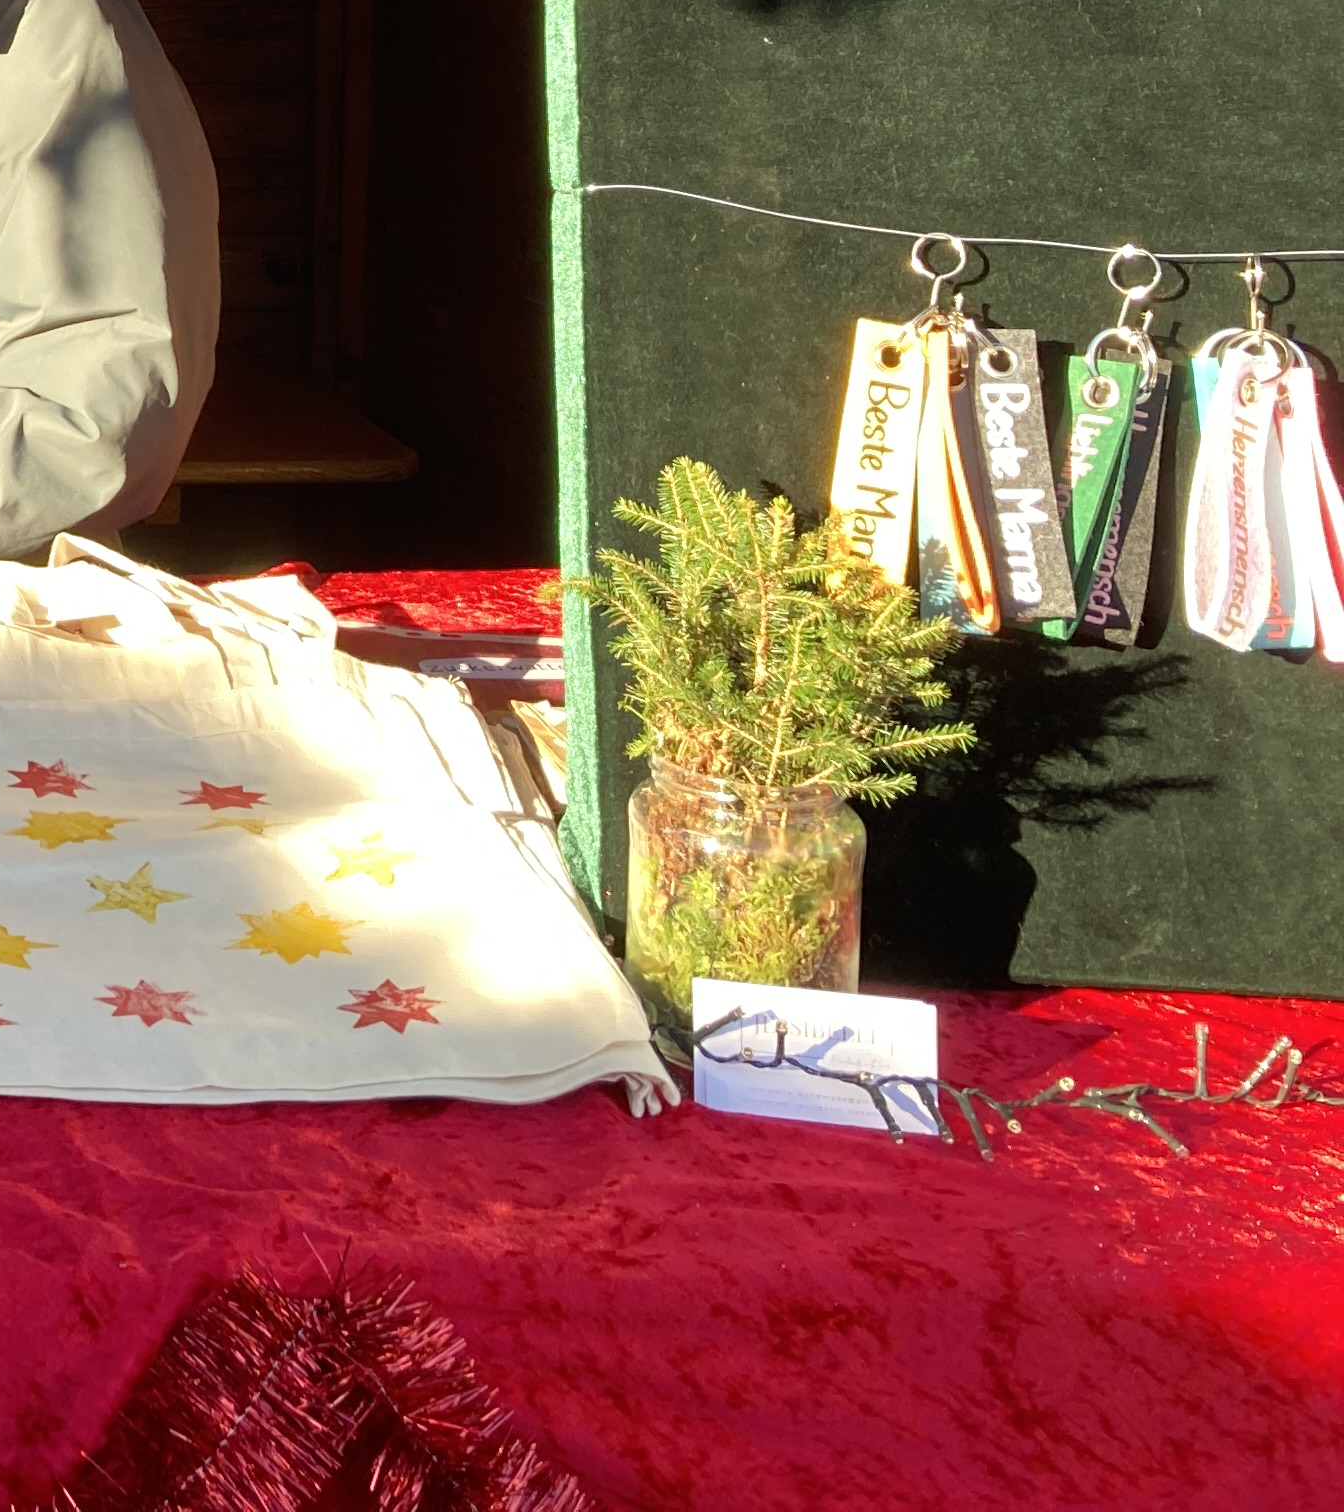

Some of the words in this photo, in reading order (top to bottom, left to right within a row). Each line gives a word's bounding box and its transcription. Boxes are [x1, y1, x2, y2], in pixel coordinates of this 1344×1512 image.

[859, 379, 911, 471] Beste
[980, 383, 1030, 480] Beste
[994, 488, 1045, 606] Mama
[1216, 415, 1261, 638] Herzensmensch
